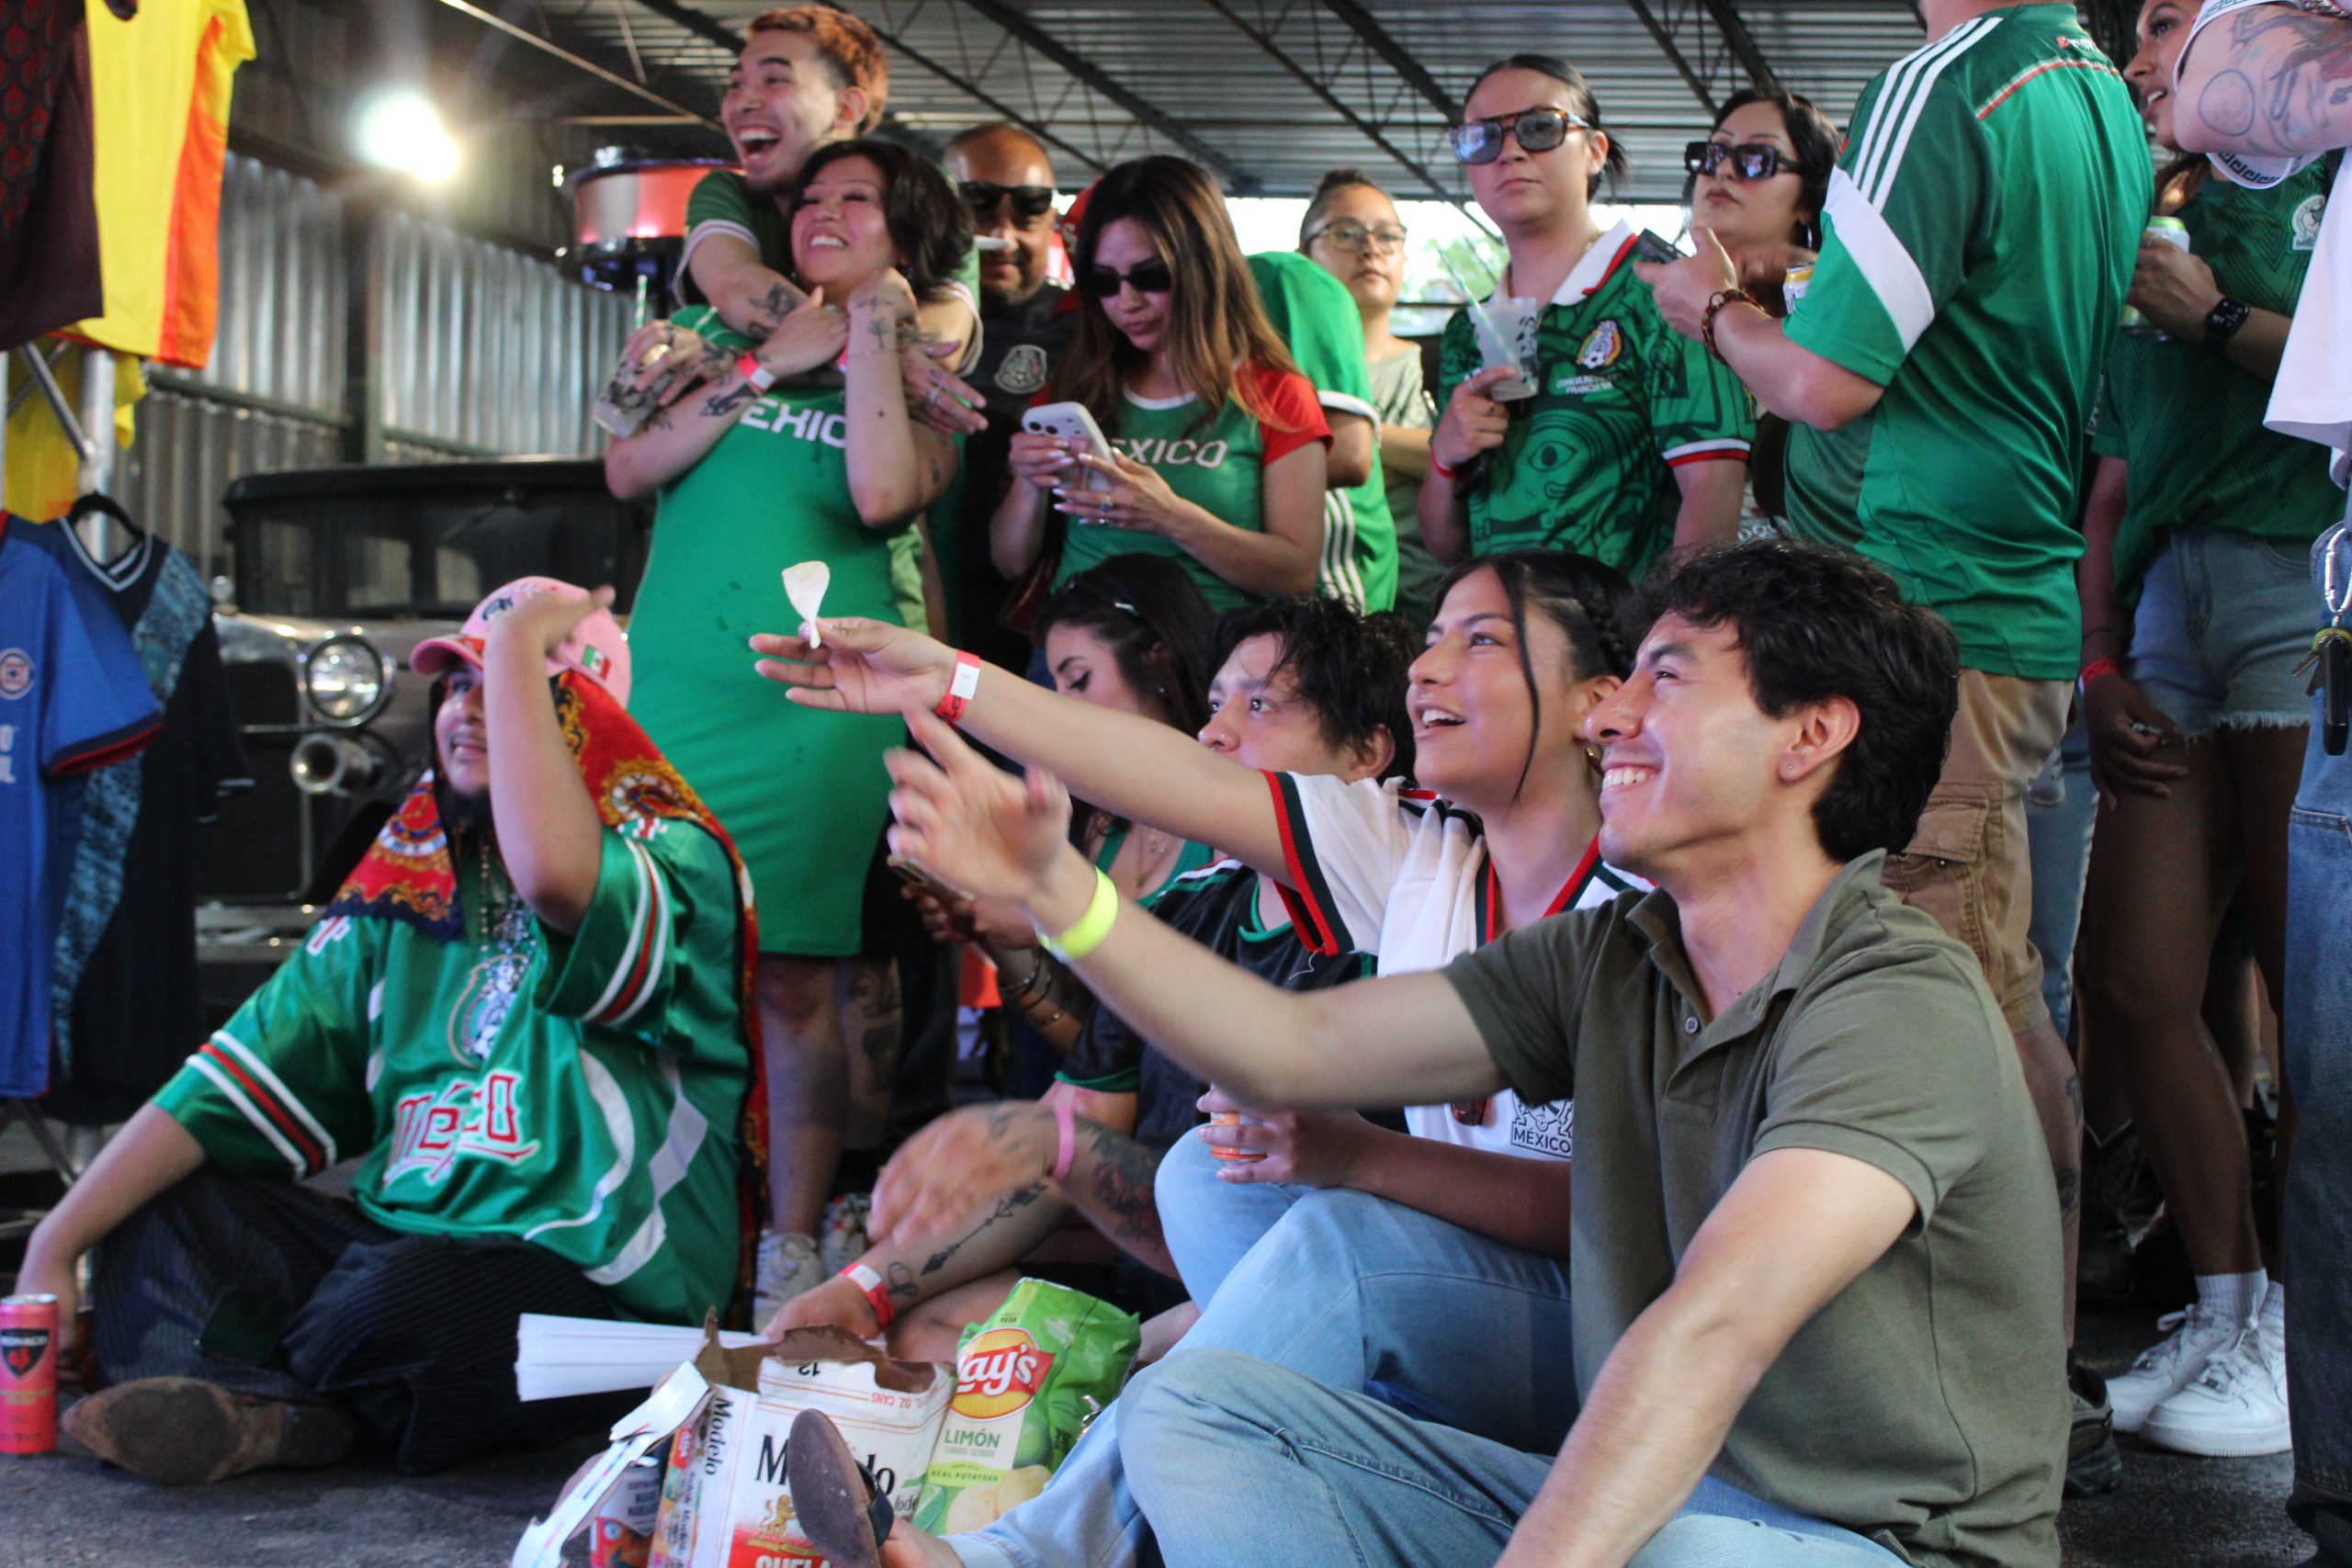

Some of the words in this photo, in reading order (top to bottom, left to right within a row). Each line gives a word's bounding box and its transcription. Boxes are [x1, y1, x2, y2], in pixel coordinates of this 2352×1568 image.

[740, 396, 845, 448] EXIC
[1112, 438, 1228, 468] XICO
[1513, 1127, 1571, 1154] MÉXICO
[956, 1343, 1038, 1396] Lay's
[705, 1397, 734, 1476] Modelo
[944, 1427, 1001, 1448] LIMÓN
